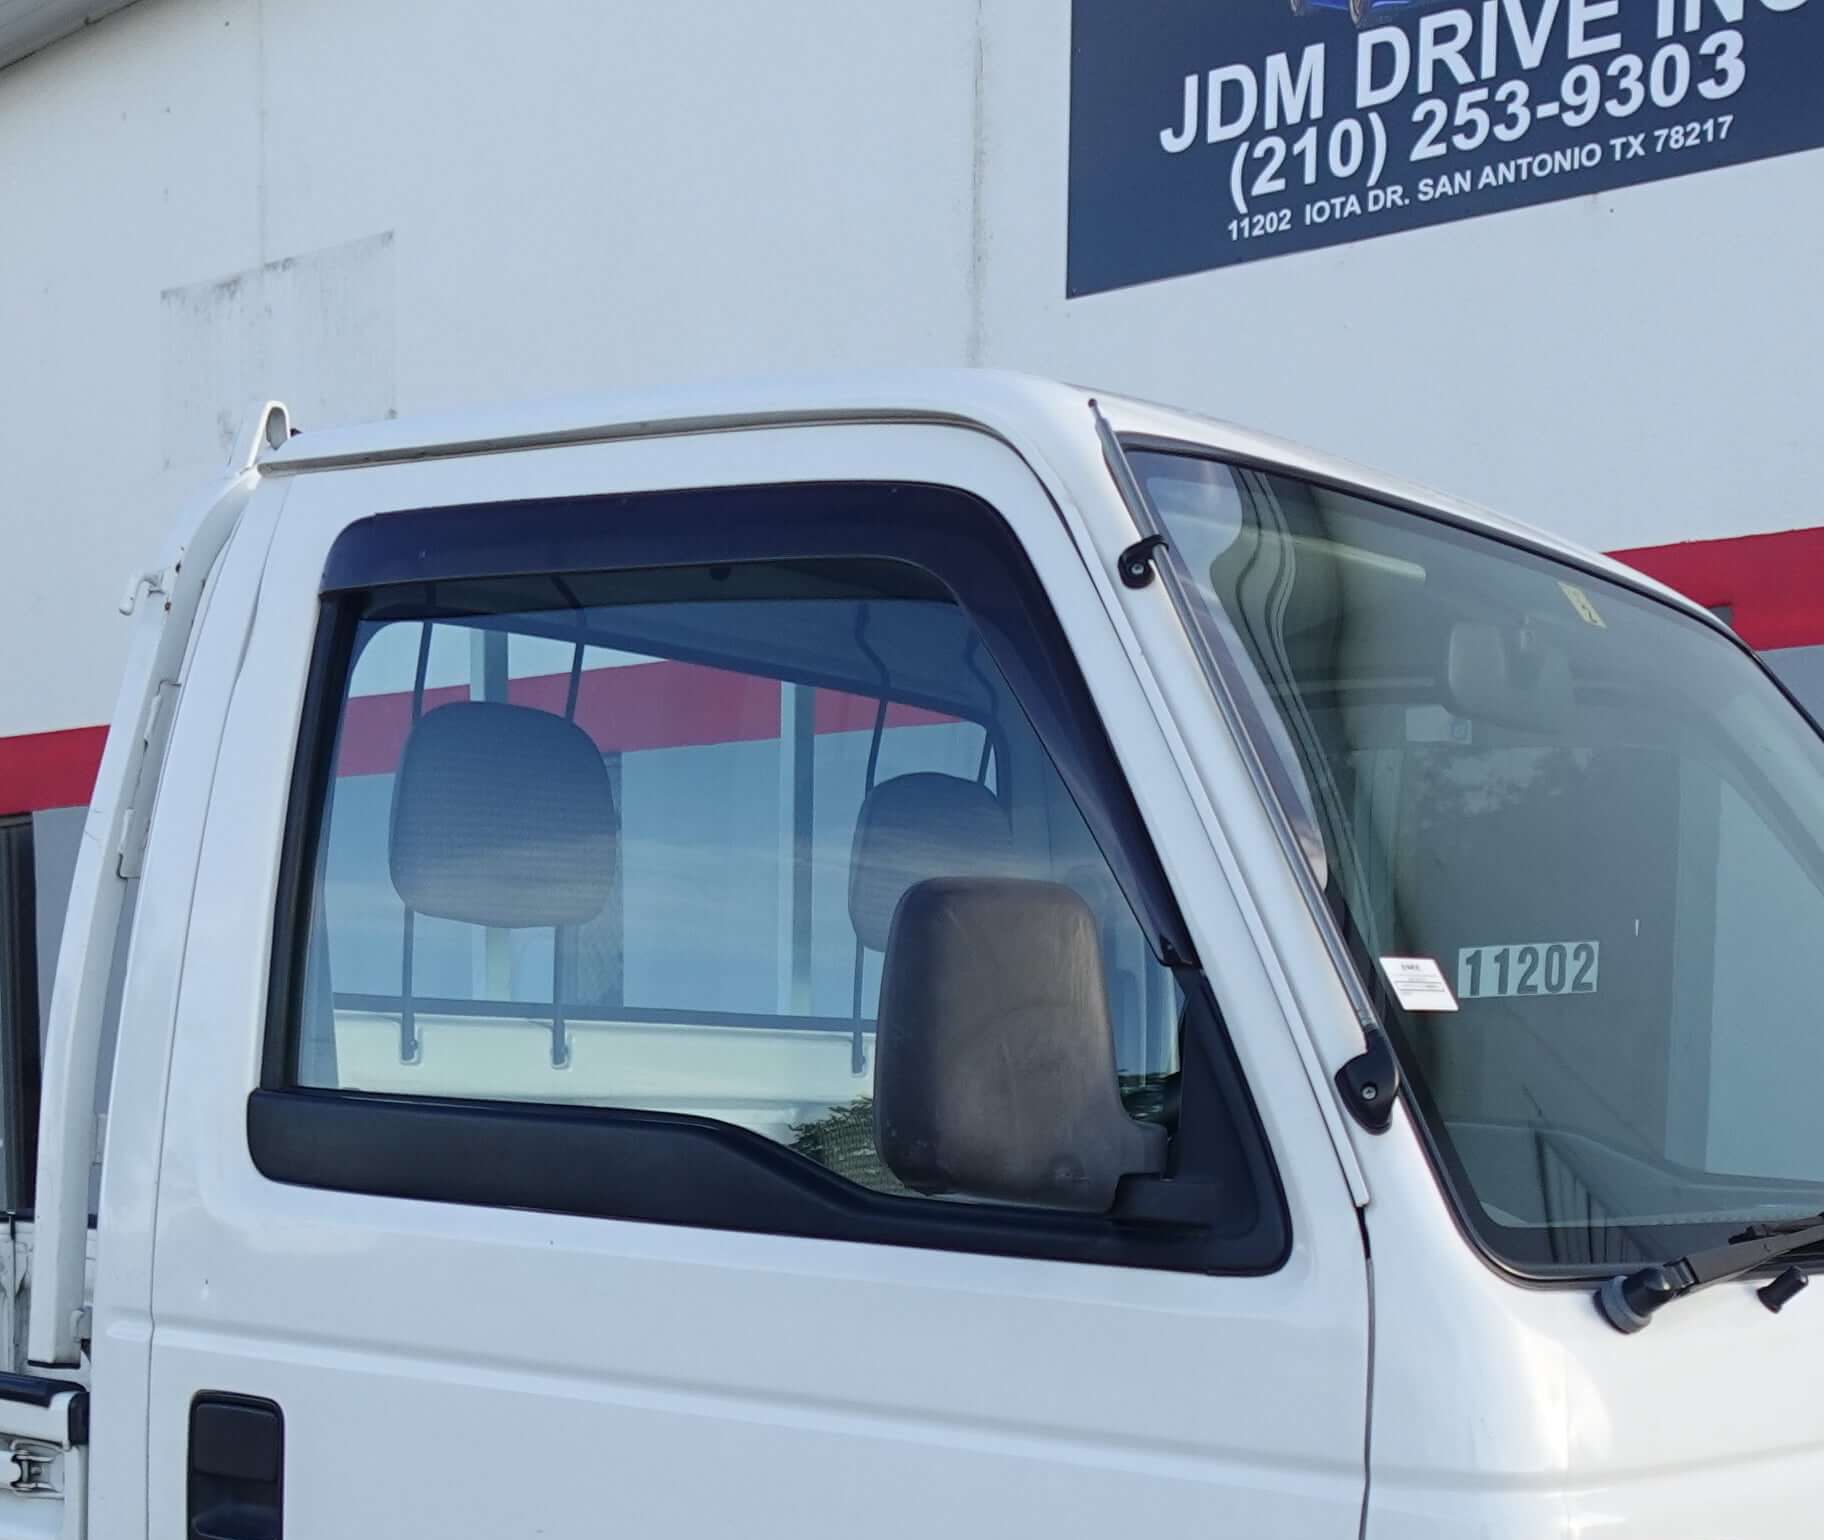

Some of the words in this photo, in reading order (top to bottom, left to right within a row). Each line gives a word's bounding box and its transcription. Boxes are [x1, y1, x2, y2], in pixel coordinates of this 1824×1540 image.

[1159, 42, 1325, 153] JDM
[1356, 0, 1622, 109] DRIVE
[1230, 111, 1388, 214] (210)
[1409, 29, 1747, 162] 253-9303
[1228, 207, 1292, 241] 11202
[1305, 194, 1362, 225] IOTA
[1367, 185, 1410, 212] DR.
[1417, 169, 1472, 201] SAN
[1477, 143, 1602, 190] ANTONIO
[1609, 133, 1645, 161] TX
[1653, 114, 1734, 153] 78217
[1465, 943, 1595, 997] 11202
